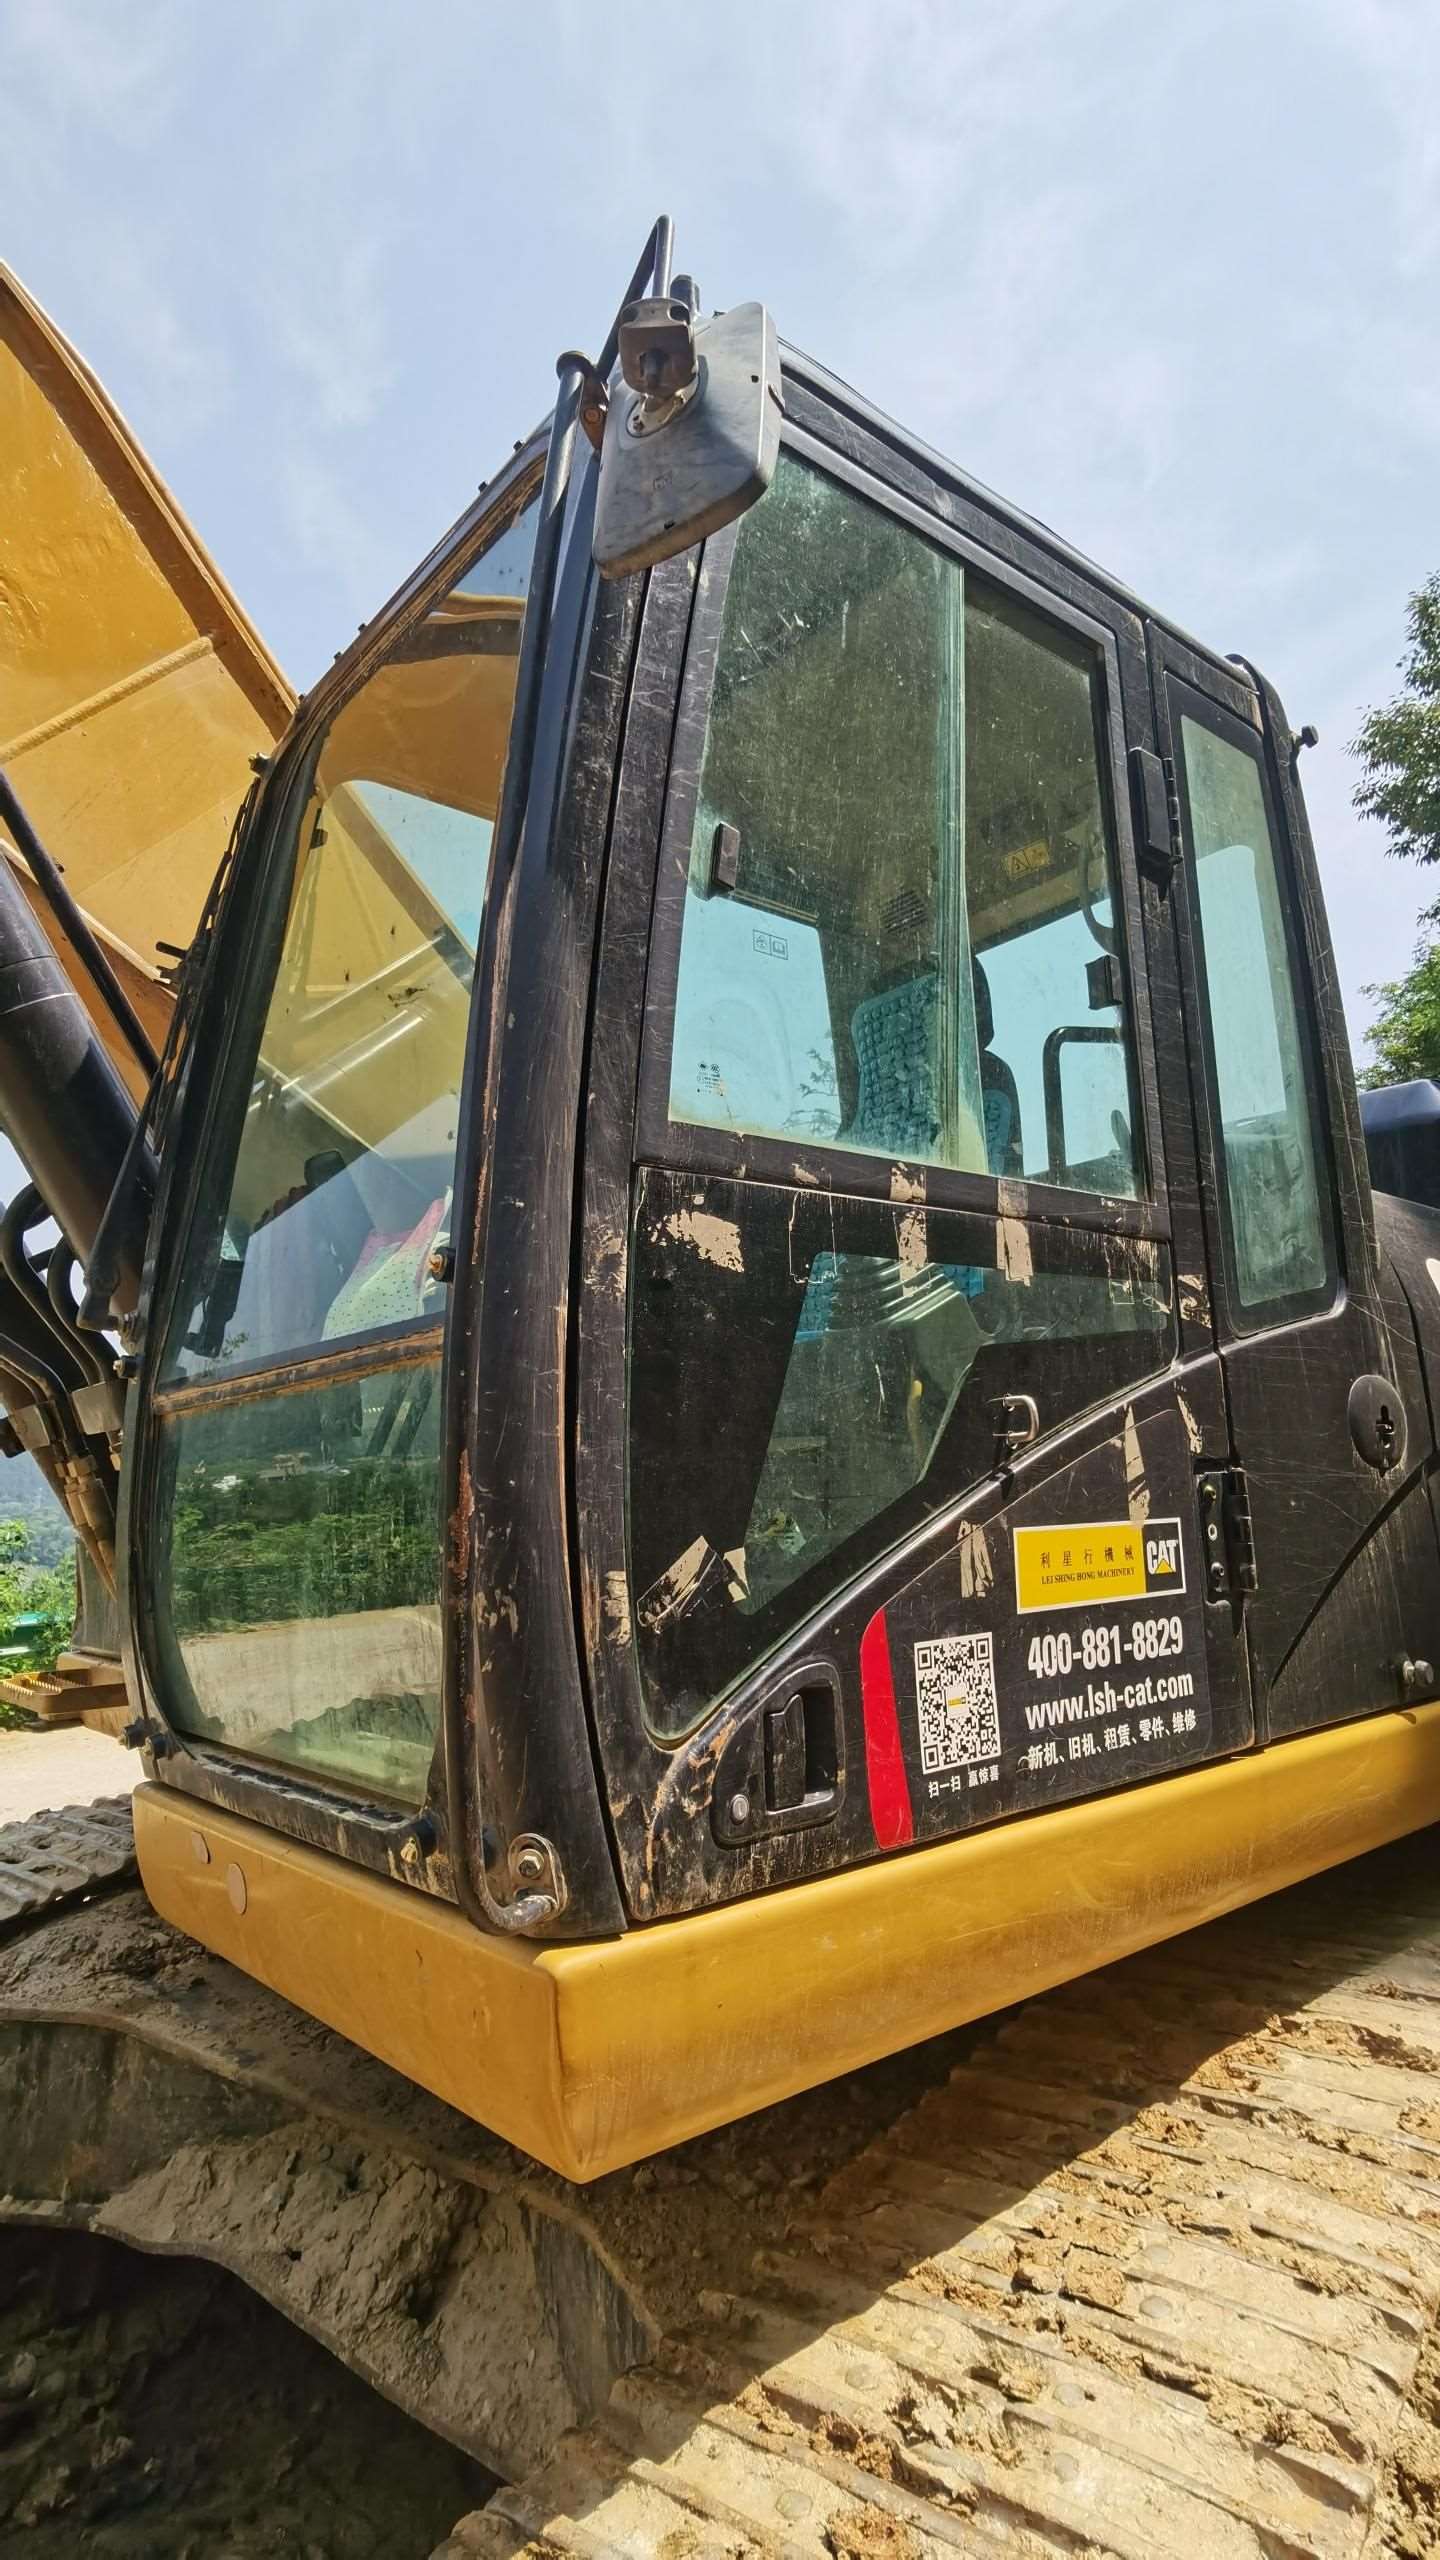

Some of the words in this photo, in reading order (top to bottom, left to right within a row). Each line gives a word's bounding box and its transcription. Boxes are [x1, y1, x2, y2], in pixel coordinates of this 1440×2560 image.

[1097, 1567, 1135, 1579] MACHINERY
[1146, 1539, 1178, 1575] CAT
[1028, 1616, 1183, 1679] 400-881-8829
[1025, 1672, 1194, 1730] www.lsh-cat.com
[928, 1775, 961, 1799] 扫一扫
